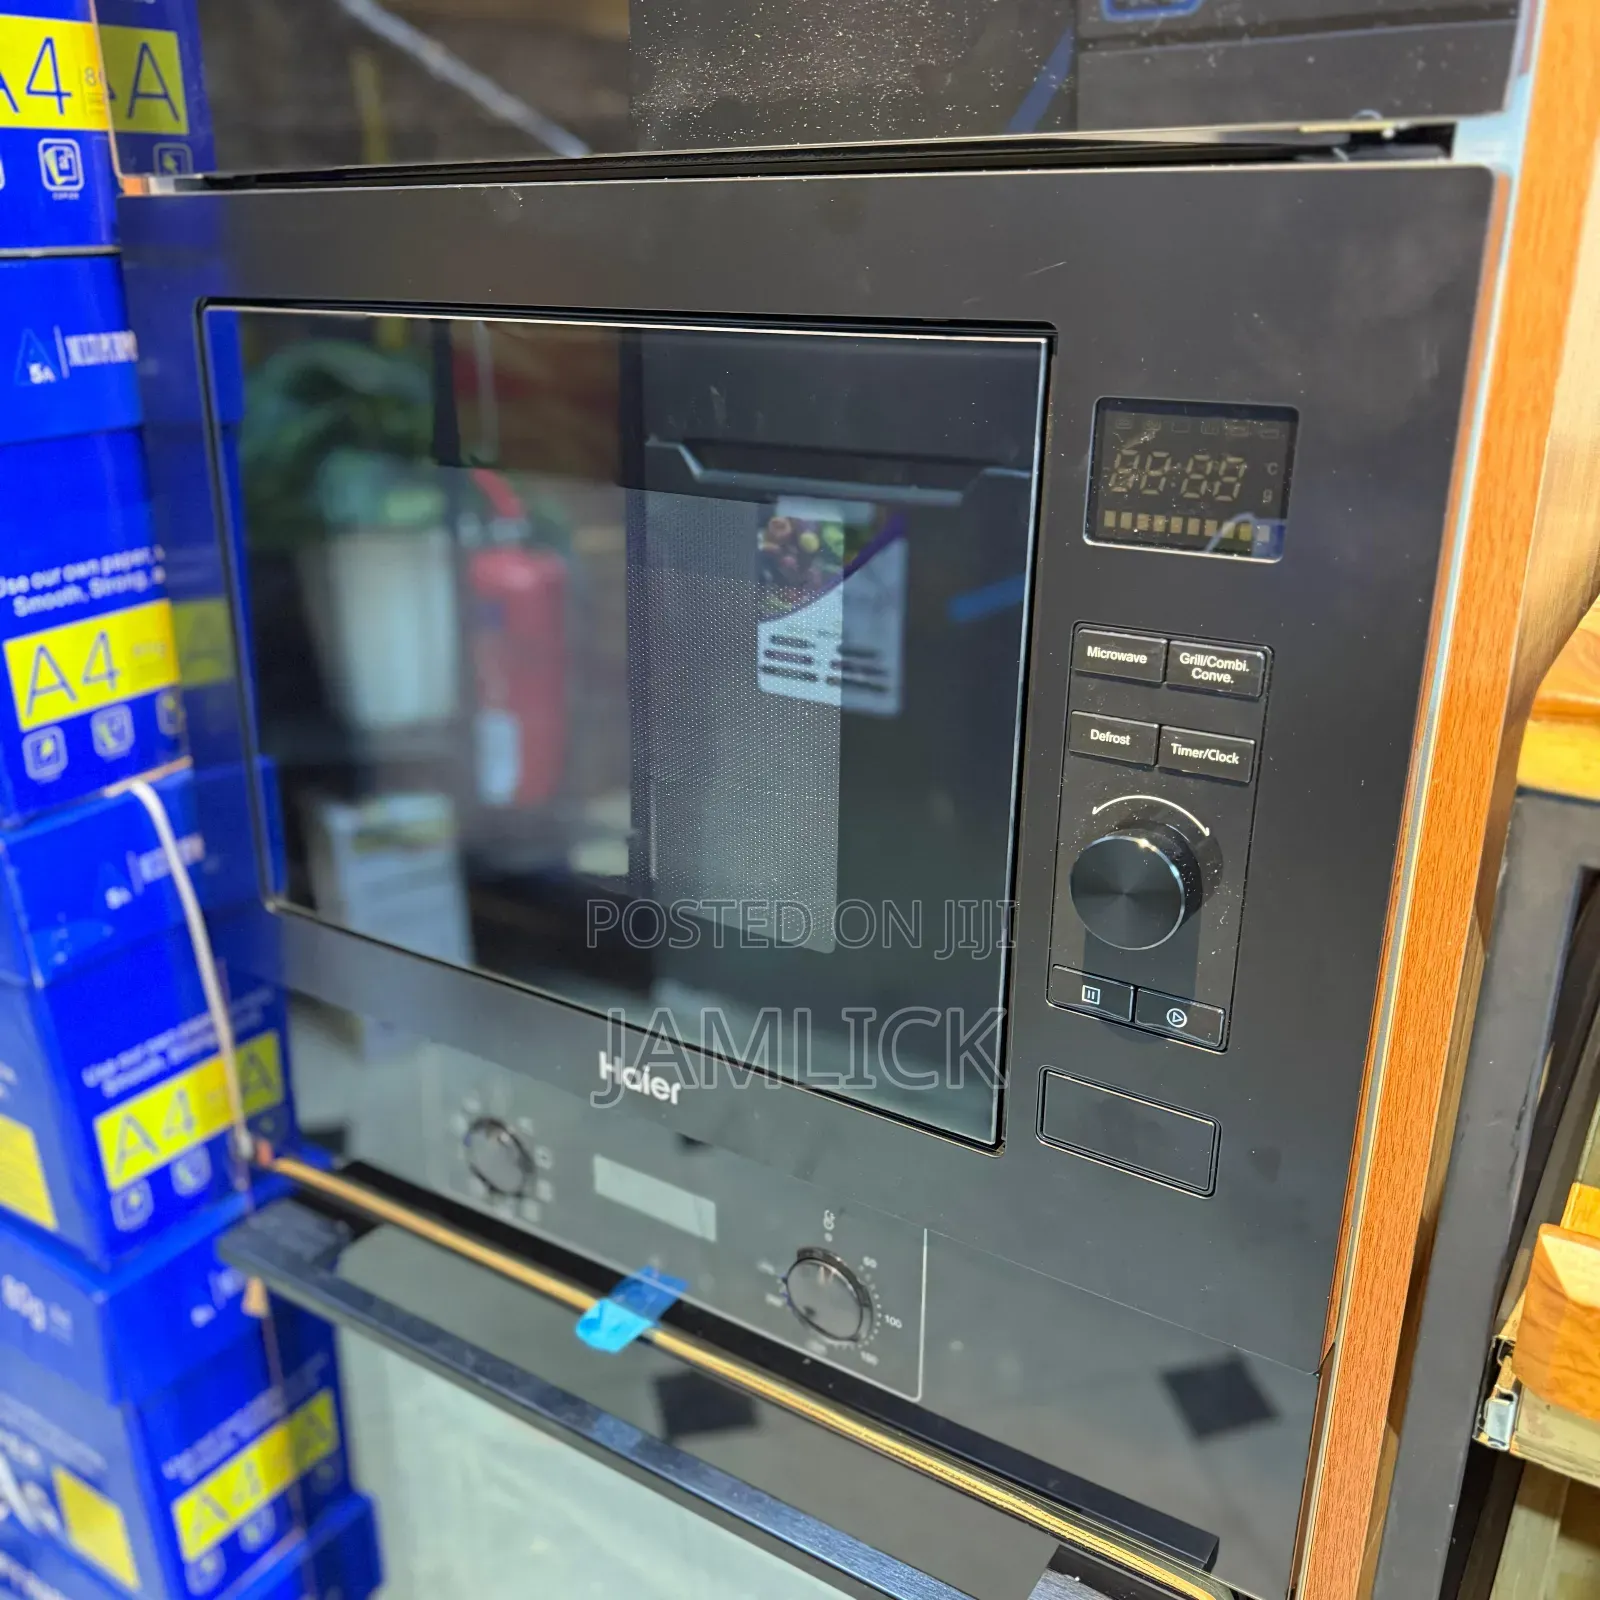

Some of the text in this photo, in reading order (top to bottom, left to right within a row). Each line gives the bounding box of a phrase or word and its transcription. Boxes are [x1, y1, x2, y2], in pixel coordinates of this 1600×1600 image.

[1087, 646, 1148, 665] Microwave
[1179, 652, 1250, 673] Grill/Combi.
[27, 630, 121, 718] A4
[1191, 667, 1235, 684] Conve.
[1090, 729, 1131, 746] Defrost
[1170, 743, 1240, 765] Timer/Clock
[599, 1050, 681, 1106] Haier
